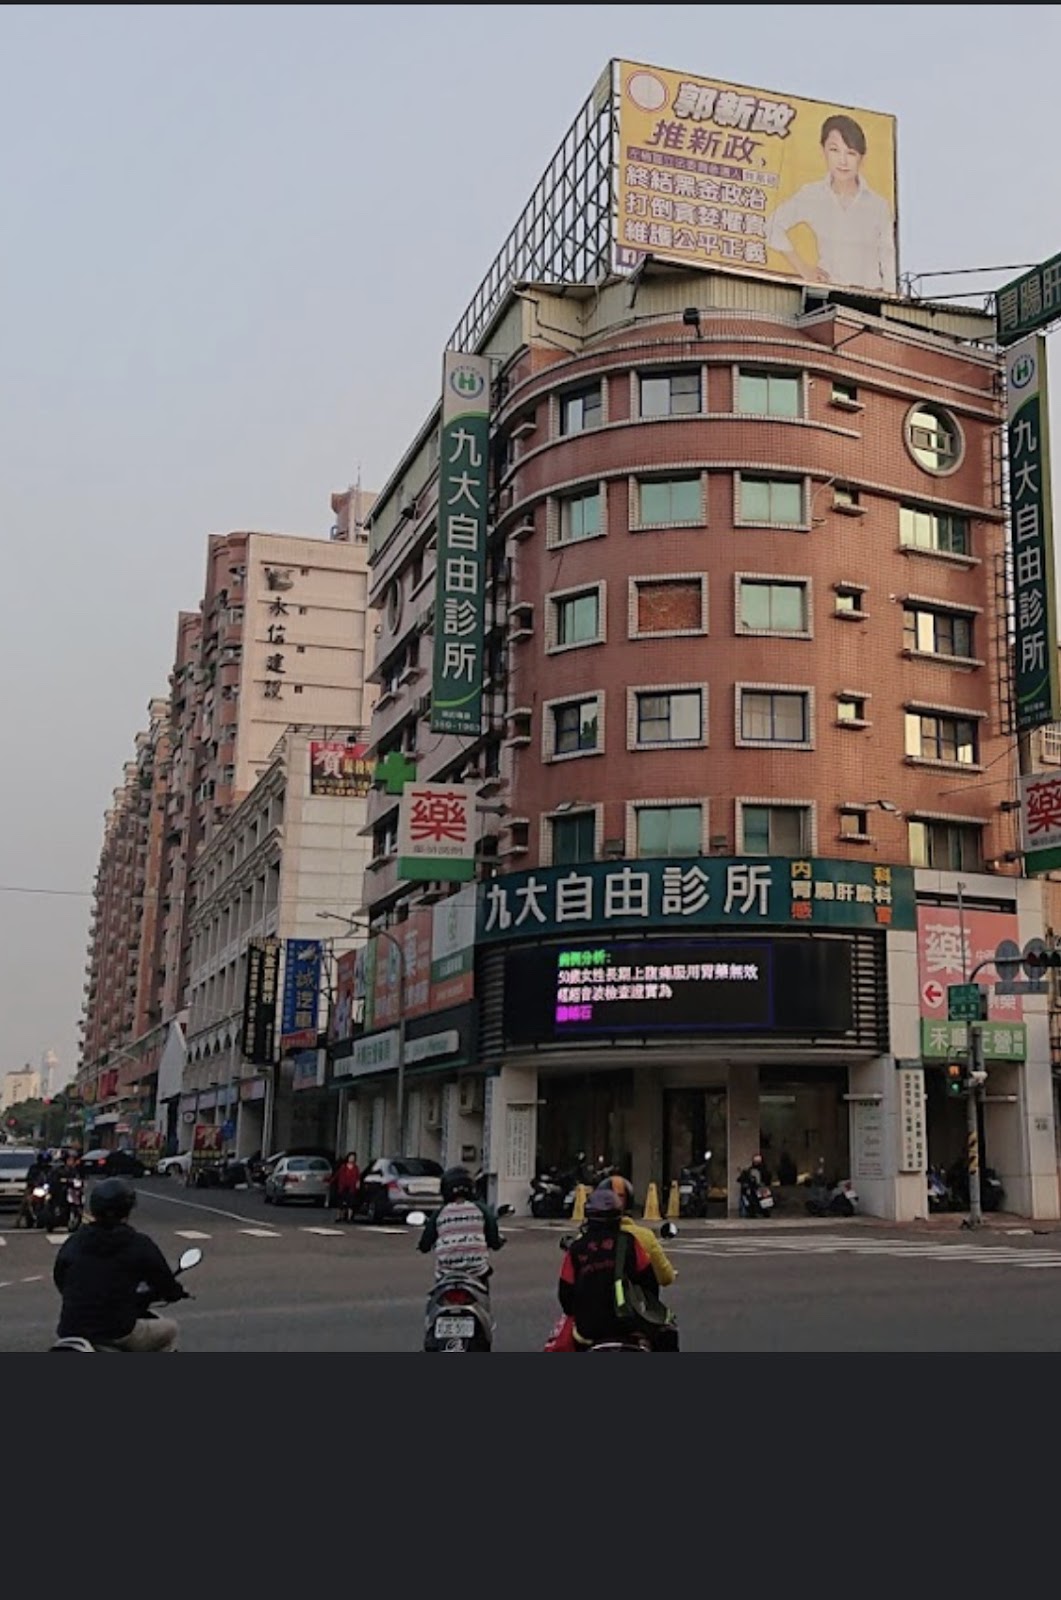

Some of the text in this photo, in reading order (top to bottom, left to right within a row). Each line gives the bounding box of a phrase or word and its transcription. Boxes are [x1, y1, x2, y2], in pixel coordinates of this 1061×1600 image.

[673, 81, 797, 139] 郭新政
[625, 164, 767, 210] 終結黑金政治
[625, 219, 767, 264] 維護公平正義
[442, 428, 482, 683] 九大自由診所
[1013, 418, 1045, 674] 九大自由診所
[410, 790, 467, 842] 藥
[485, 864, 772, 932] 九大自由診所
[925, 923, 972, 975] 藥
